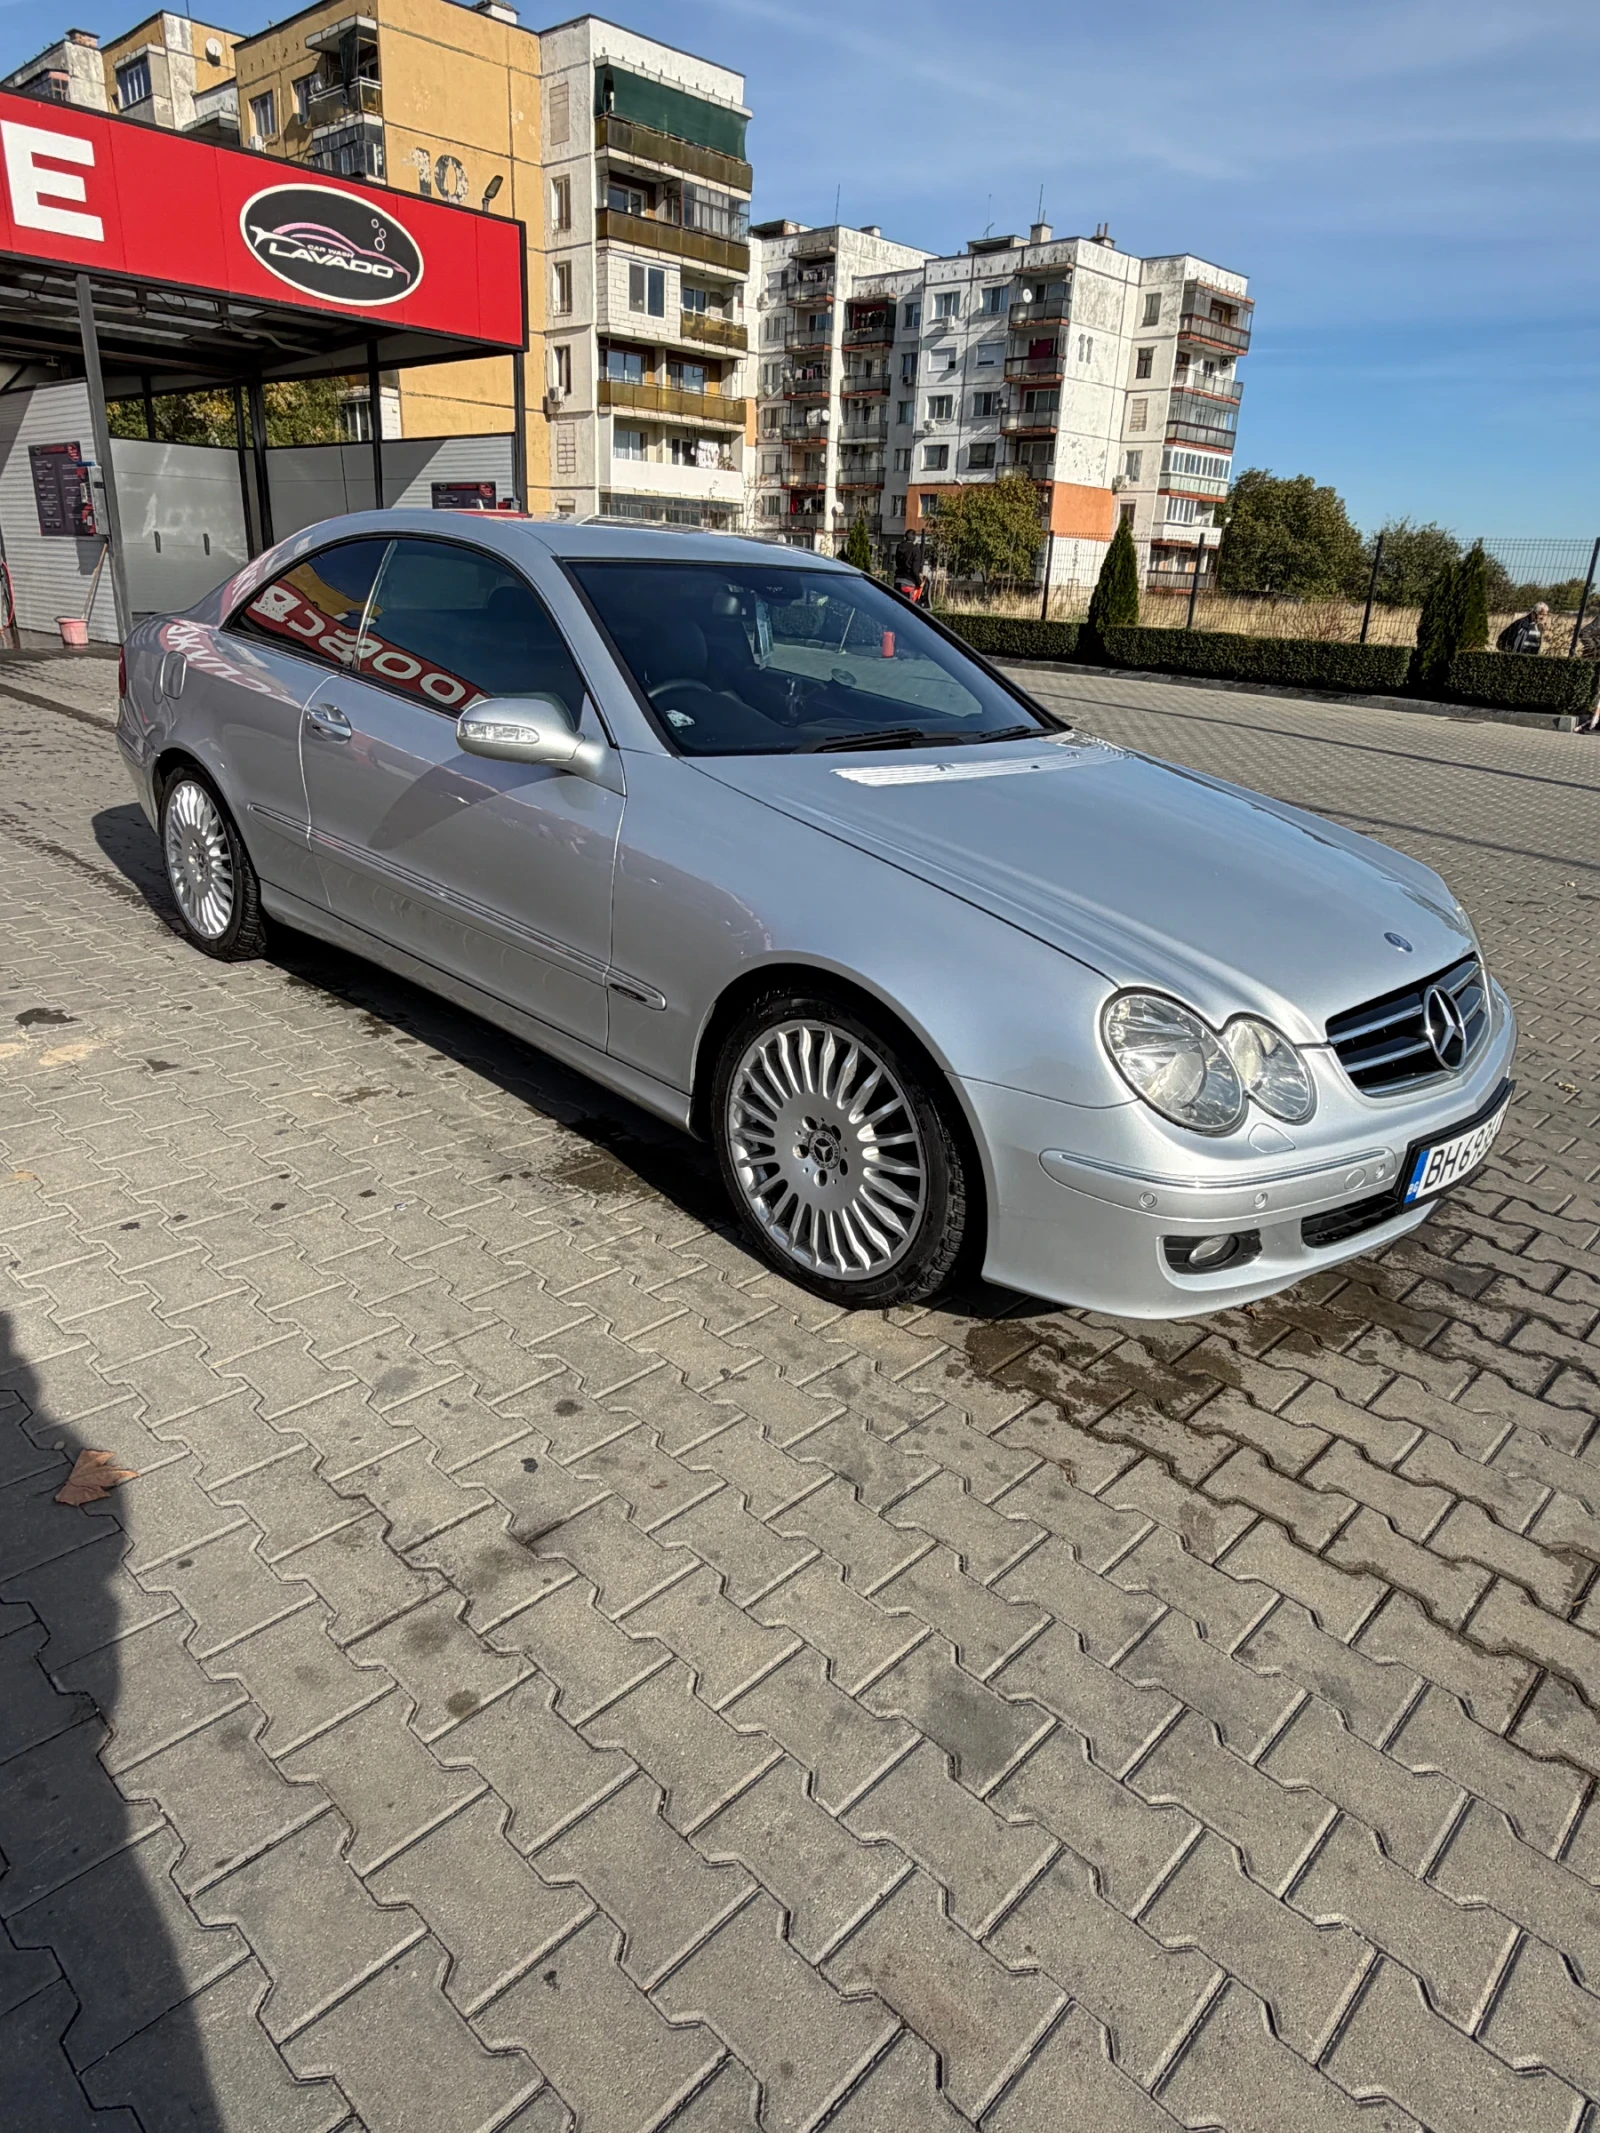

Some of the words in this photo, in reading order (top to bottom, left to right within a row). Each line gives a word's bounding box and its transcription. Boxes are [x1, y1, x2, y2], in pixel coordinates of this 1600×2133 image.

[411, 147, 470, 204] 10
[268, 242, 394, 279] LAVADO
[307, 244, 327, 253] CAR
[328, 247, 354, 258] WASH
[1078, 333, 1094, 365] 11
[1408, 1181, 1420, 1194] BG
